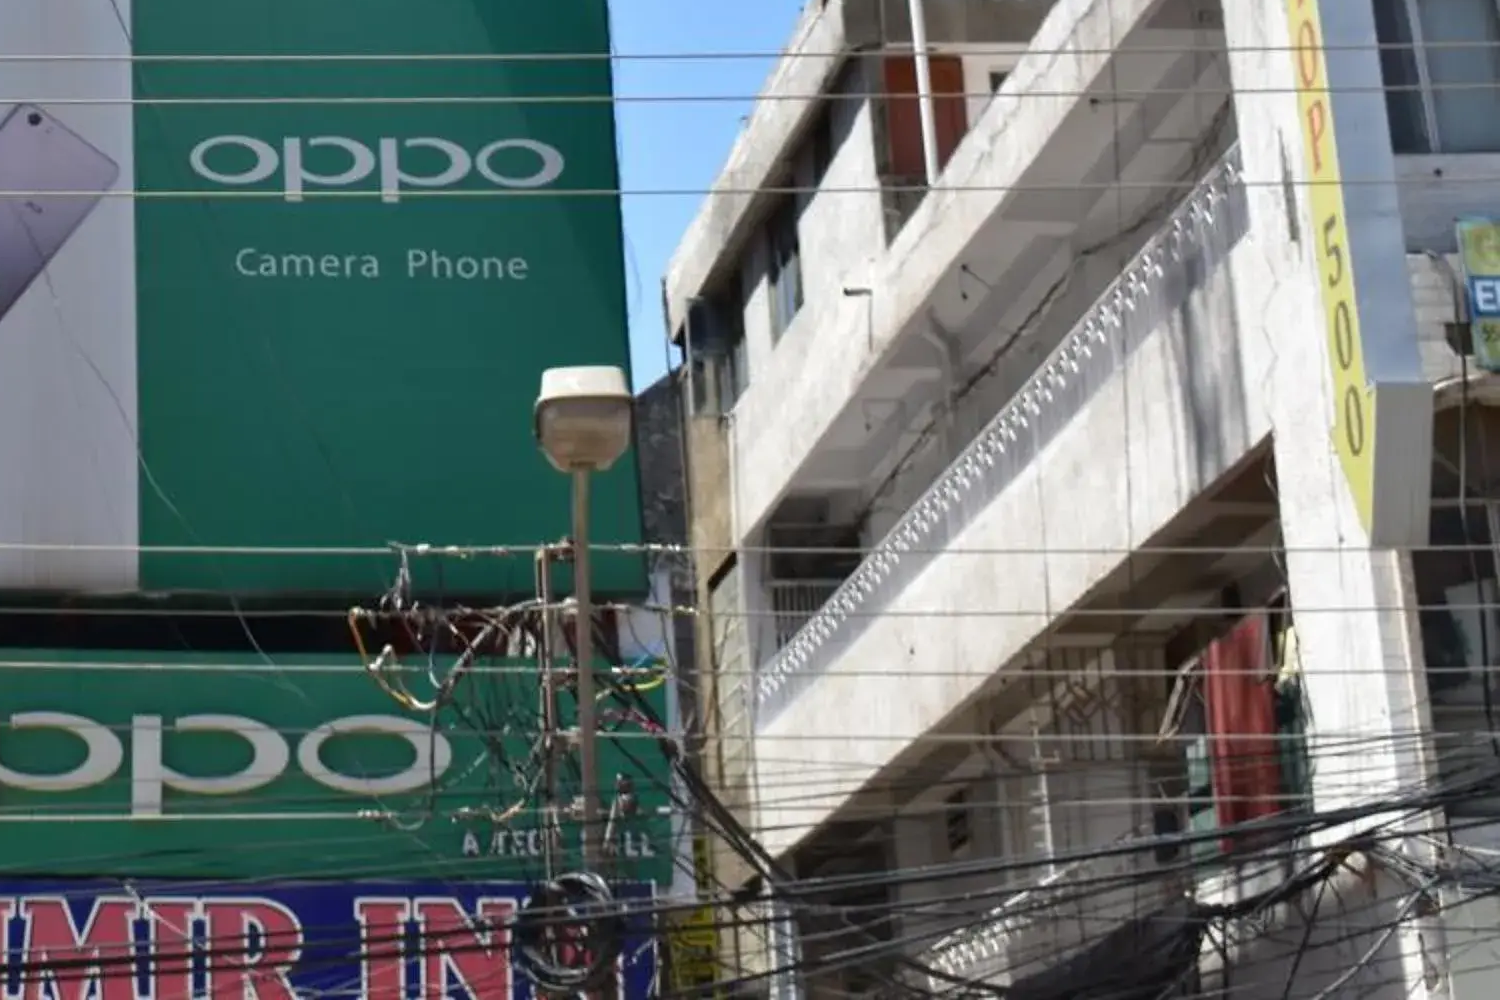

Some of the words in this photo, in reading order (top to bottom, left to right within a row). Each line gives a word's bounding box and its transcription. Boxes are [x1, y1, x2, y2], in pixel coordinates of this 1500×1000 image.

[235, 248, 380, 278] Camera
[407, 249, 529, 280] Phone
[1322, 213, 1365, 458] 500
